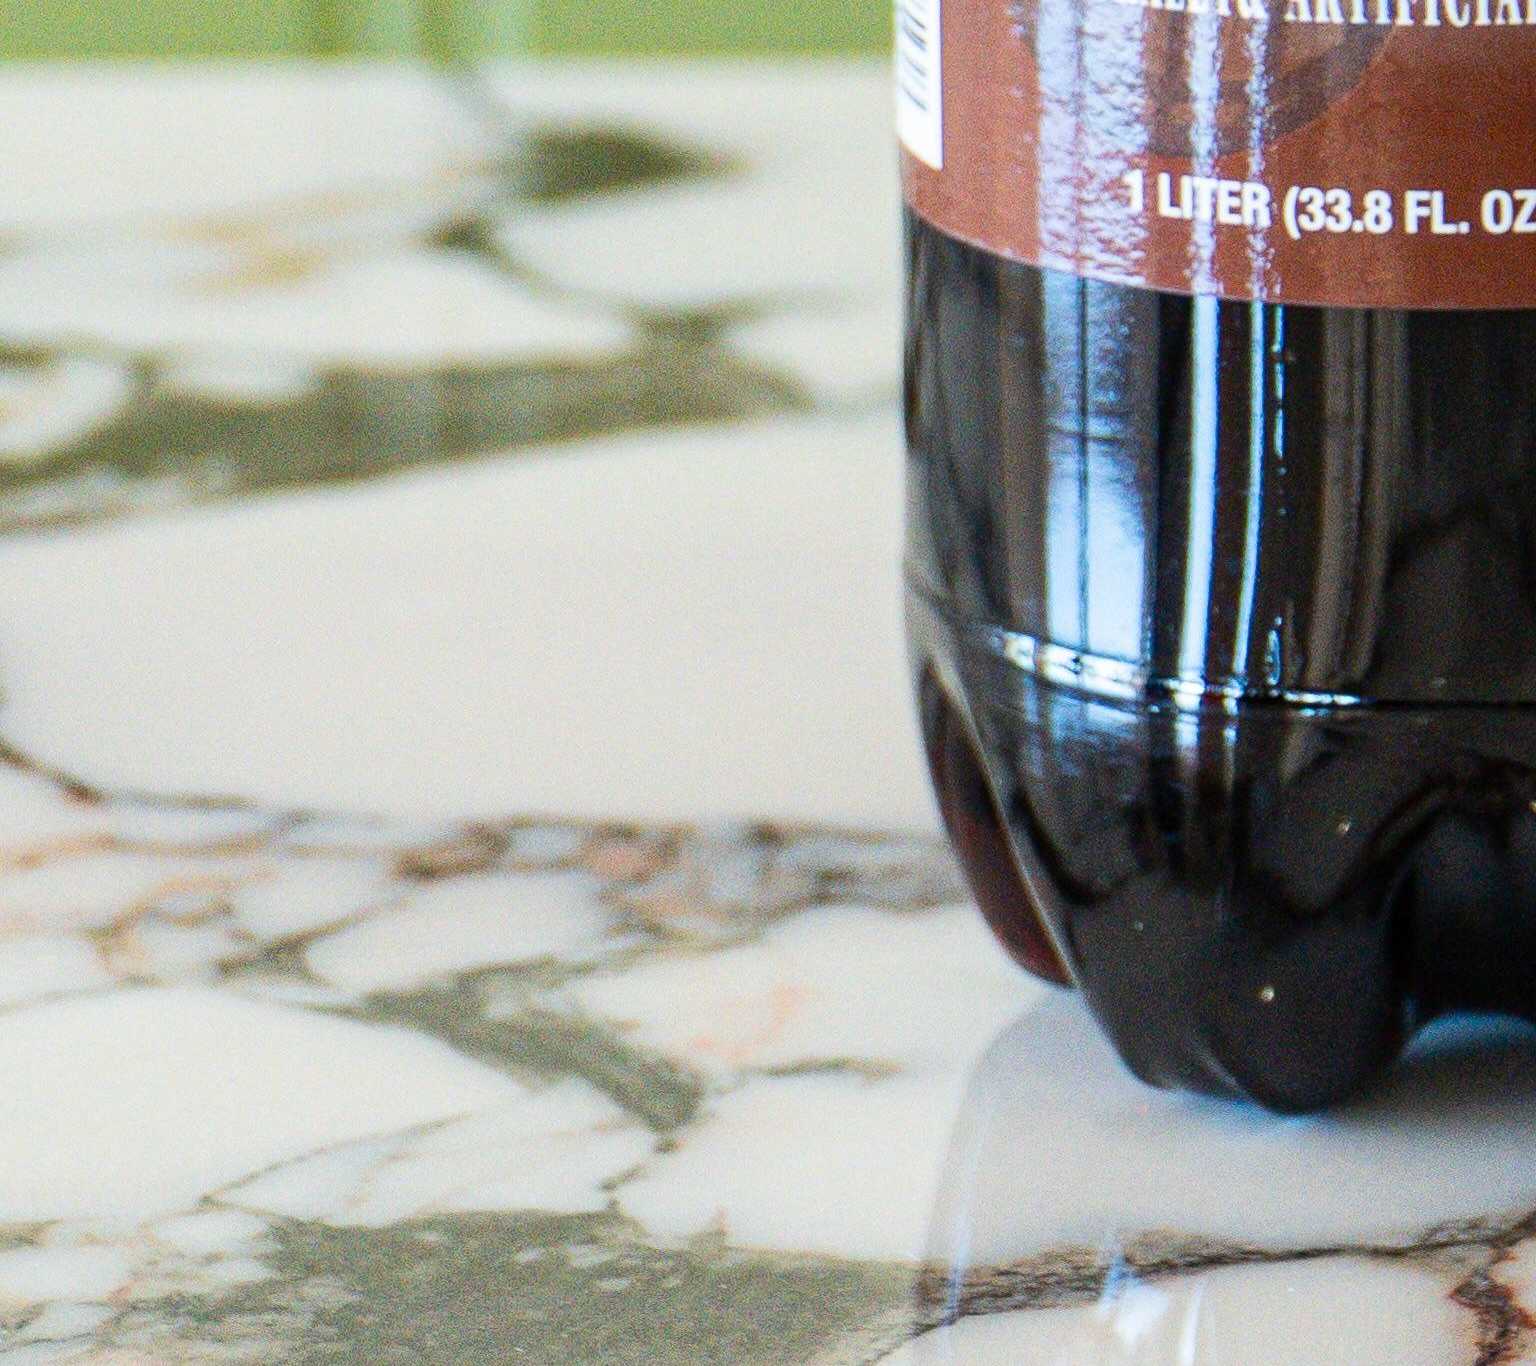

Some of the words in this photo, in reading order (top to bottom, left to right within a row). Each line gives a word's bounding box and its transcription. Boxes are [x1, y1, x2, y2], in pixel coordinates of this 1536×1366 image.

[1123, 169, 1144, 213] 1
[1157, 172, 1273, 229] LITER
[1283, 186, 1393, 240] (33.8
[1404, 190, 1471, 235] FL.
